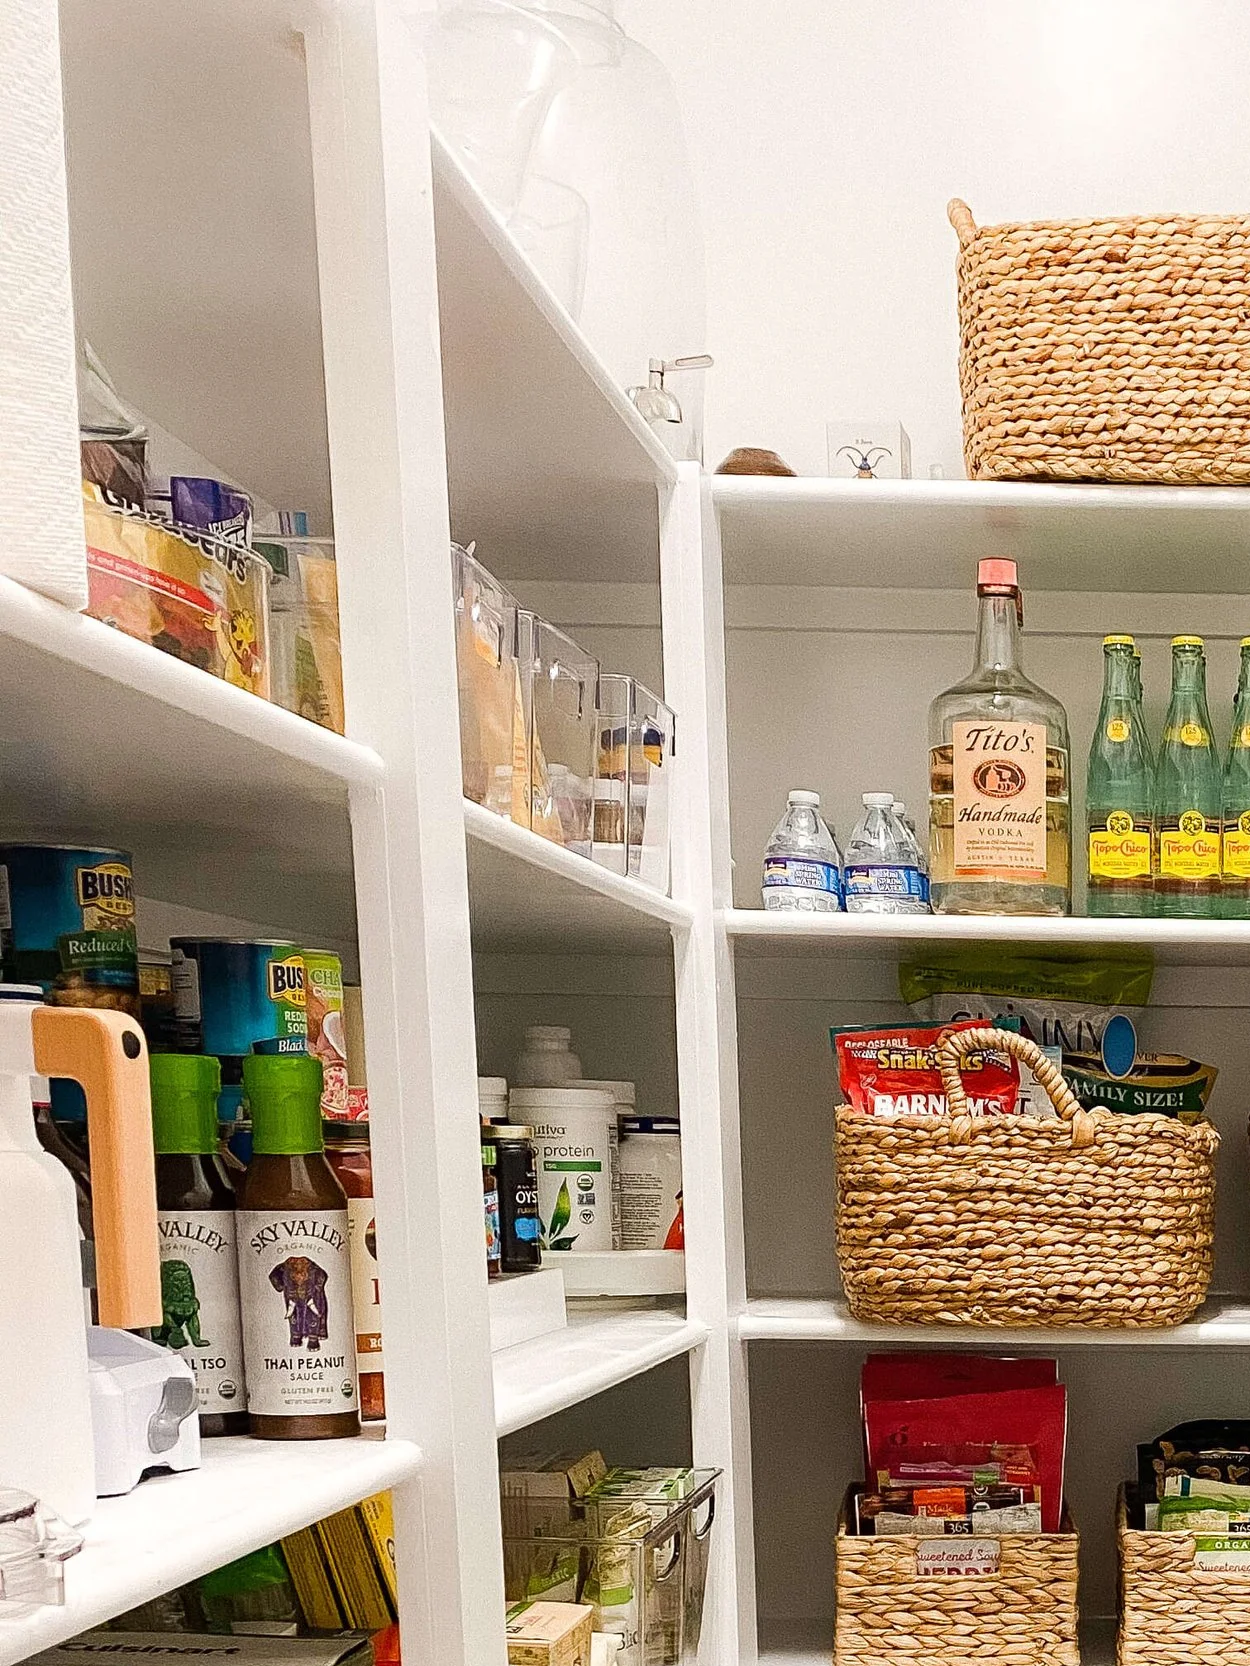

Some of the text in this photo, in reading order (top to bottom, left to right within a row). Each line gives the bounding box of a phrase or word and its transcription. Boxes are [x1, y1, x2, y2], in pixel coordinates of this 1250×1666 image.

[965, 726, 1034, 754] Tito's
[958, 803, 1043, 824] Handmade
[978, 827, 1023, 838] VODKA
[1092, 839, 1147, 857] Topo Chico
[1164, 839, 1217, 857] Topo Chico
[82, 871, 133, 900] BUSH
[69, 938, 125, 955] Reduced
[273, 965, 303, 993] BUS
[877, 1049, 984, 1071] Snak-Sks
[873, 1094, 1001, 1118] BARNM'S
[1134, 1092, 1184, 1108] SIZE!
[535, 1124, 566, 1136] utiva
[543, 1145, 595, 1158] protein
[515, 1191, 538, 1205] OYS
[158, 1220, 230, 1253] VALLEY
[250, 1219, 347, 1255] SKY VALLEY
[164, 1244, 200, 1256] GANIC
[276, 1242, 323, 1255] ORGANIC
[201, 1357, 227, 1370] TSO
[264, 1356, 345, 1371] THAI PEANUT
[289, 1371, 324, 1382] SAUCE
[948, 1521, 969, 1535] 365
[976, 1548, 1001, 1561] Sou
[58, 1642, 241, 1656] Cuisinart
